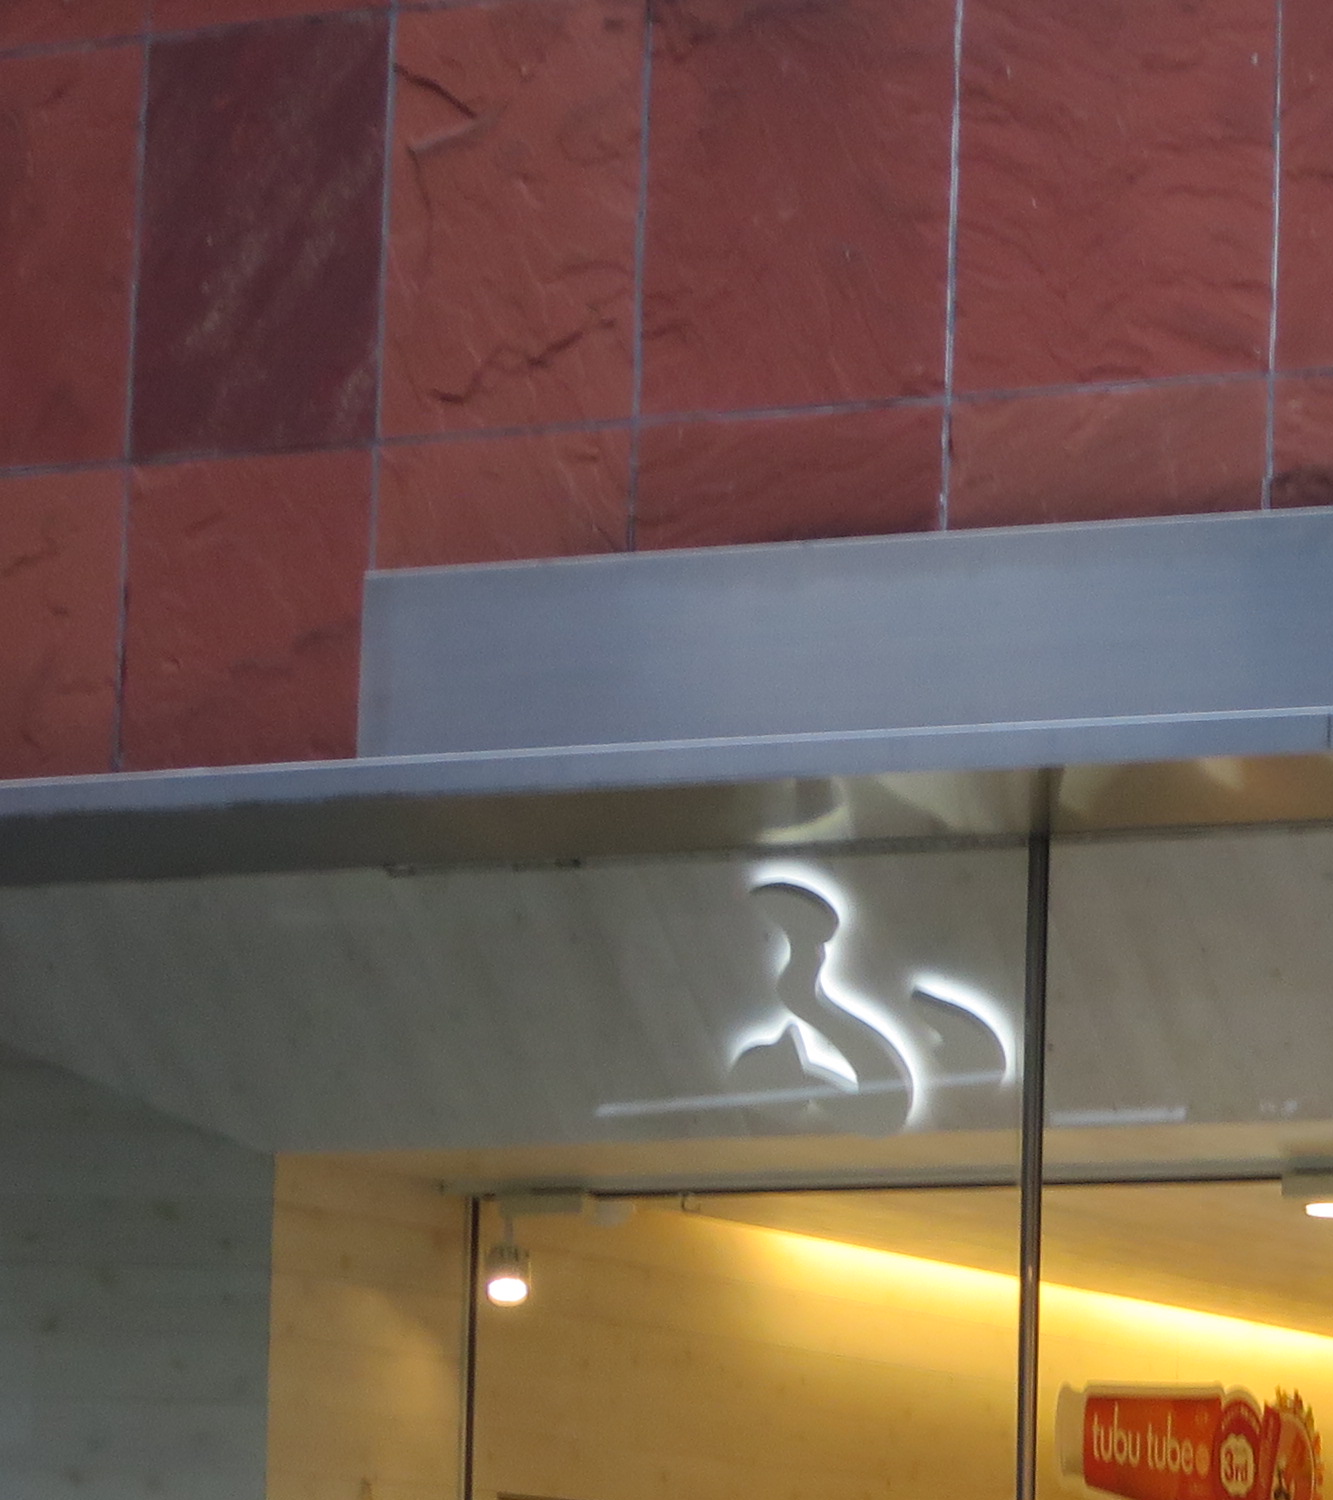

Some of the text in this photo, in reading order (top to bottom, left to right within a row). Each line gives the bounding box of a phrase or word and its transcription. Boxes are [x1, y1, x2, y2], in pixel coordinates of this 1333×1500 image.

[1092, 1401, 1195, 1476] tubu tube
[1223, 1449, 1250, 1483] 3rd
